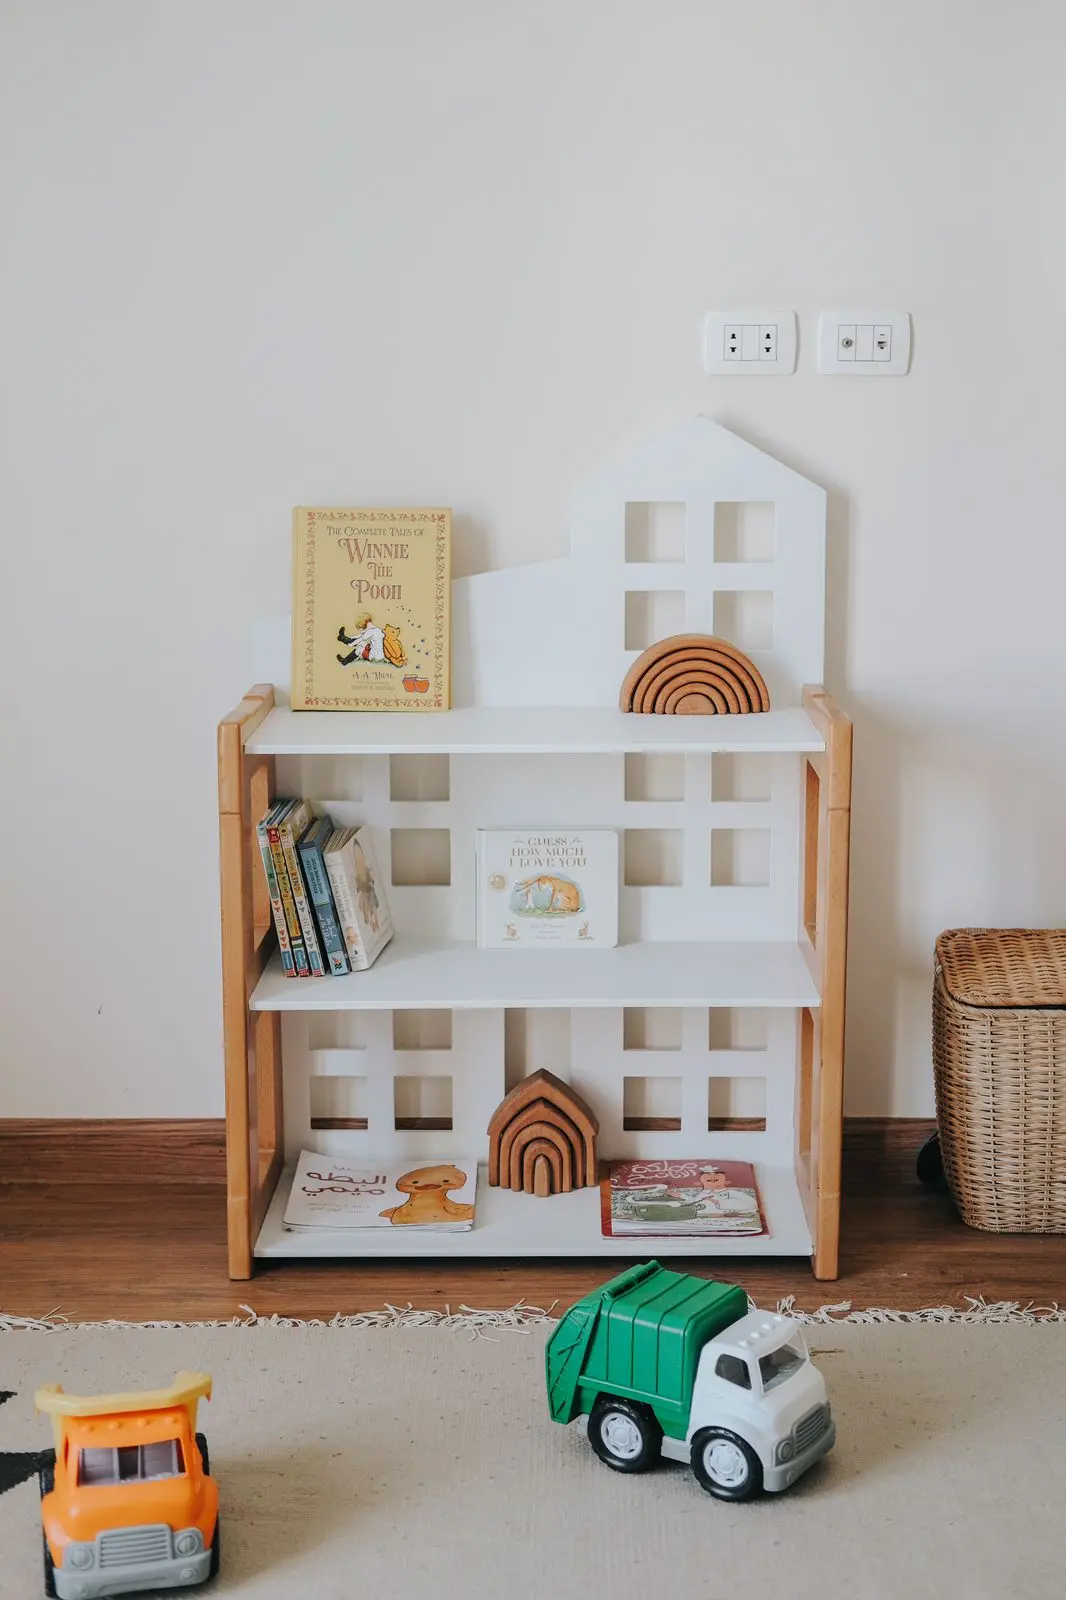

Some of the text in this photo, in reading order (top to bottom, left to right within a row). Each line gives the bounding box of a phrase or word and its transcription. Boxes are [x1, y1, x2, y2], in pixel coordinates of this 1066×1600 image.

[344, 527, 386, 536] COMPLETE
[390, 527, 412, 536] TALES
[338, 538, 409, 564] WINNIE
[367, 562, 393, 580] THE
[350, 580, 402, 603] POOH
[528, 837, 568, 846] GUESS
[512, 846, 584, 857] HOW MUCH
[509, 857, 587, 867] I LOVE YOU
